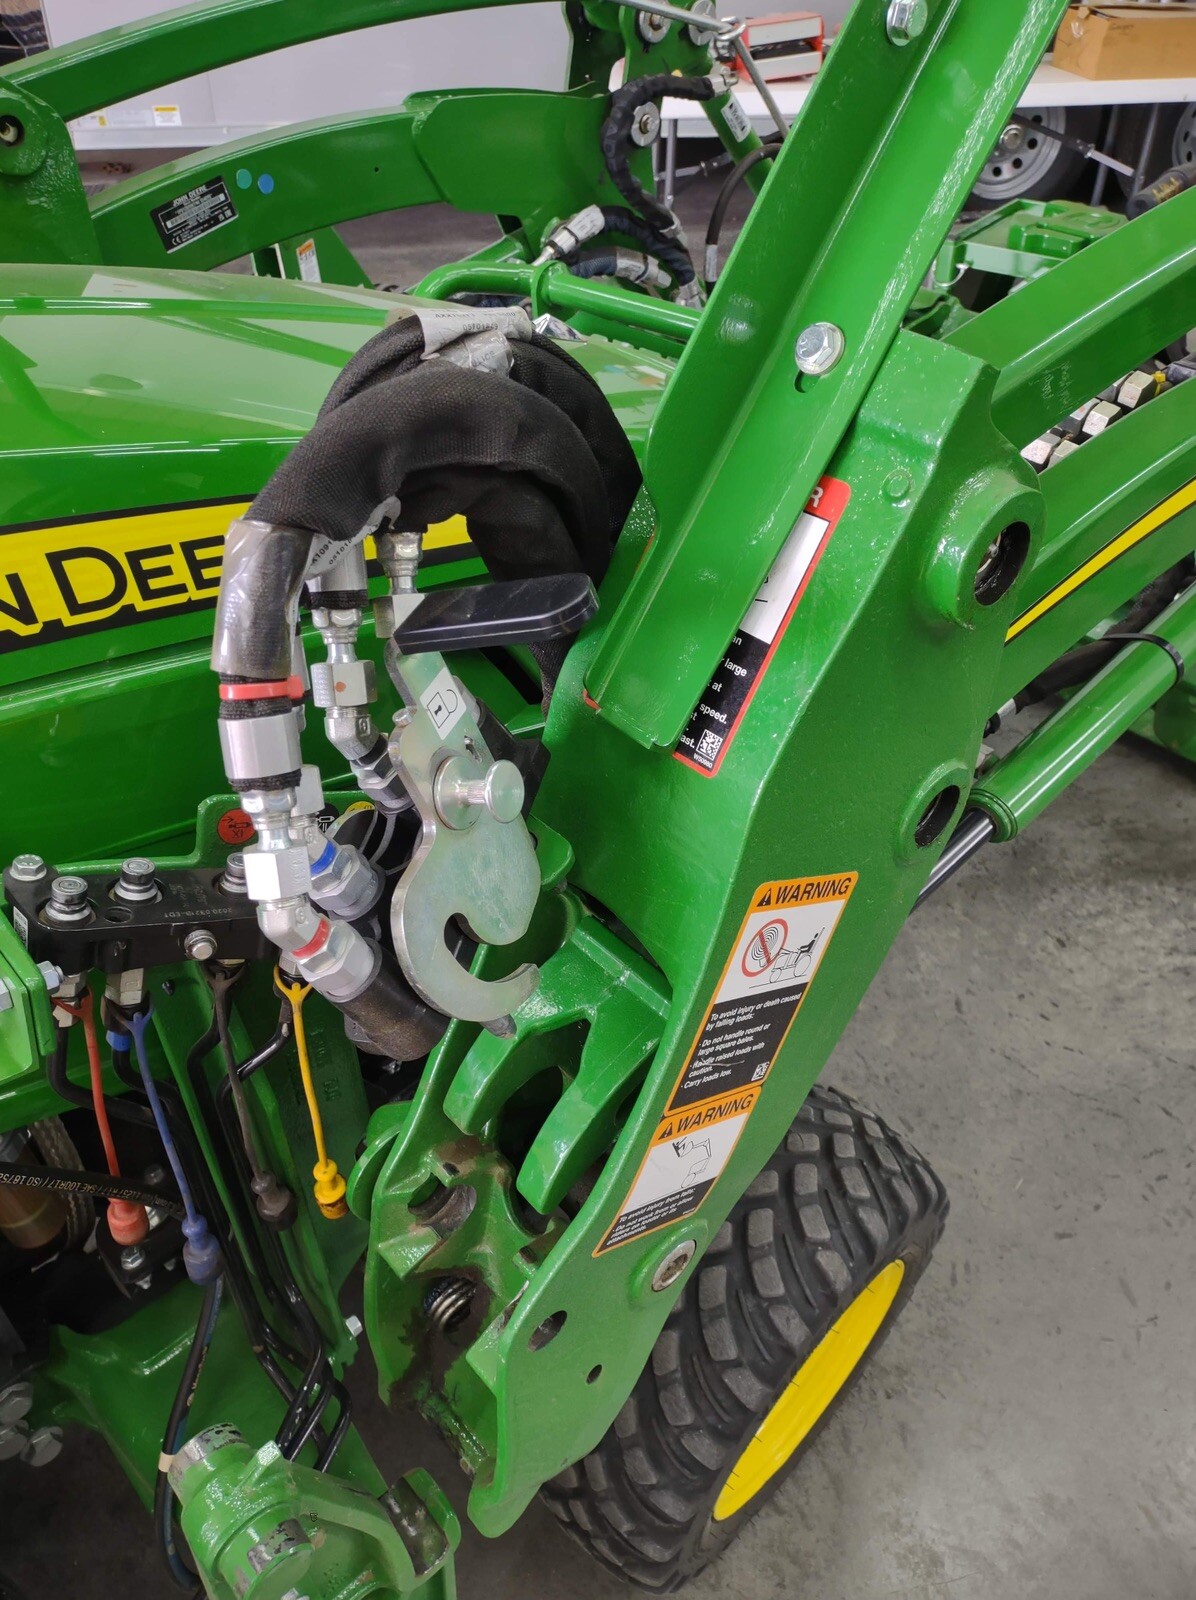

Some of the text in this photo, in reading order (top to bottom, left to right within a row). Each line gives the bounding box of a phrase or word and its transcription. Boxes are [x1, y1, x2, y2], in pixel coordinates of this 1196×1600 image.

[45, 534, 225, 617] DEE
[724, 658, 747, 676] large
[711, 682, 722, 692] at
[700, 703, 727, 724] speed.
[680, 735, 695, 748] ast.
[775, 877, 851, 904] WARNING
[711, 1013, 718, 1021] To
[719, 1008, 738, 1019] avoid
[737, 1005, 756, 1015] injury
[763, 998, 780, 1008] death
[780, 992, 802, 1004] caused
[706, 1023, 715, 1031] by
[715, 1017, 735, 1028] falling
[698, 1035, 754, 1056] large square bales.
[702, 1023, 771, 1048] Do not handle round or
[715, 1050, 736, 1062] raised
[735, 1045, 752, 1056] loads
[752, 1041, 765, 1051] with
[684, 1069, 732, 1089] Carry loads low.
[688, 1066, 713, 1078] caution.
[677, 1093, 754, 1133] WARNING
